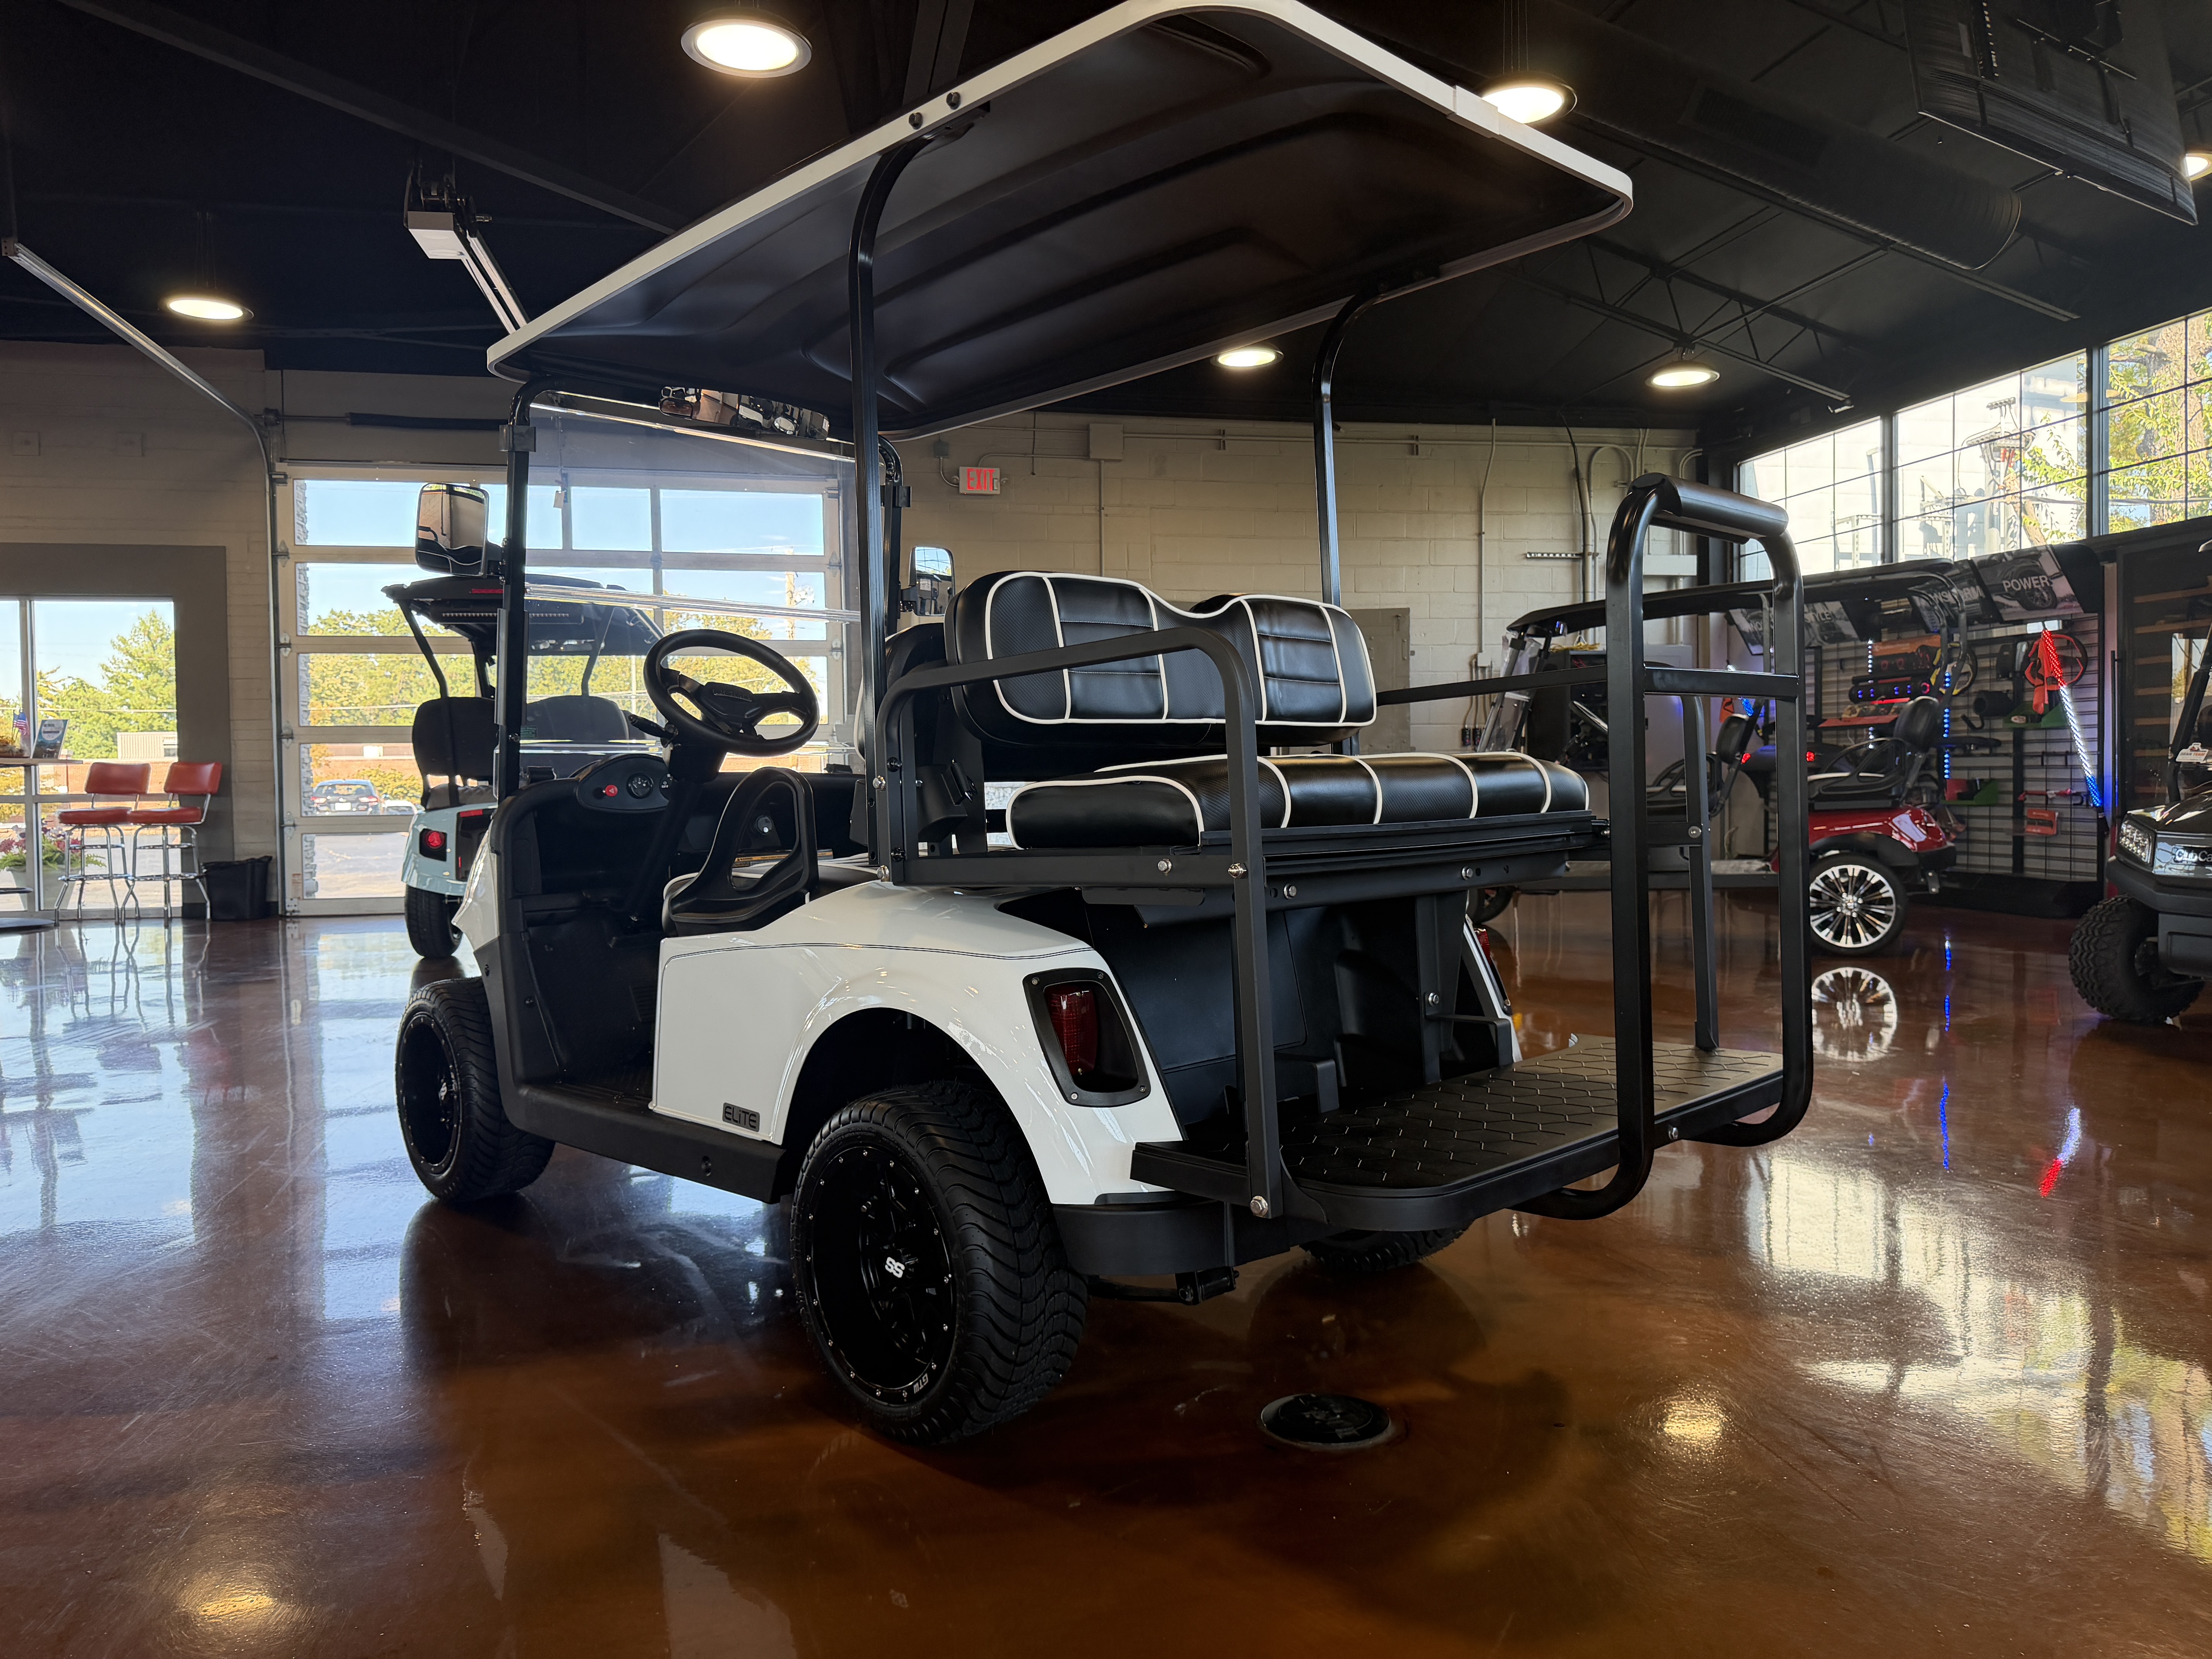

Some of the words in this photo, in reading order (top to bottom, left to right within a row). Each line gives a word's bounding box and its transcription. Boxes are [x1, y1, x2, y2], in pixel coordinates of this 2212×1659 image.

[967, 468, 995, 491] EXIT
[2003, 575, 2051, 592] POWER
[885, 1257, 905, 1278] SS
